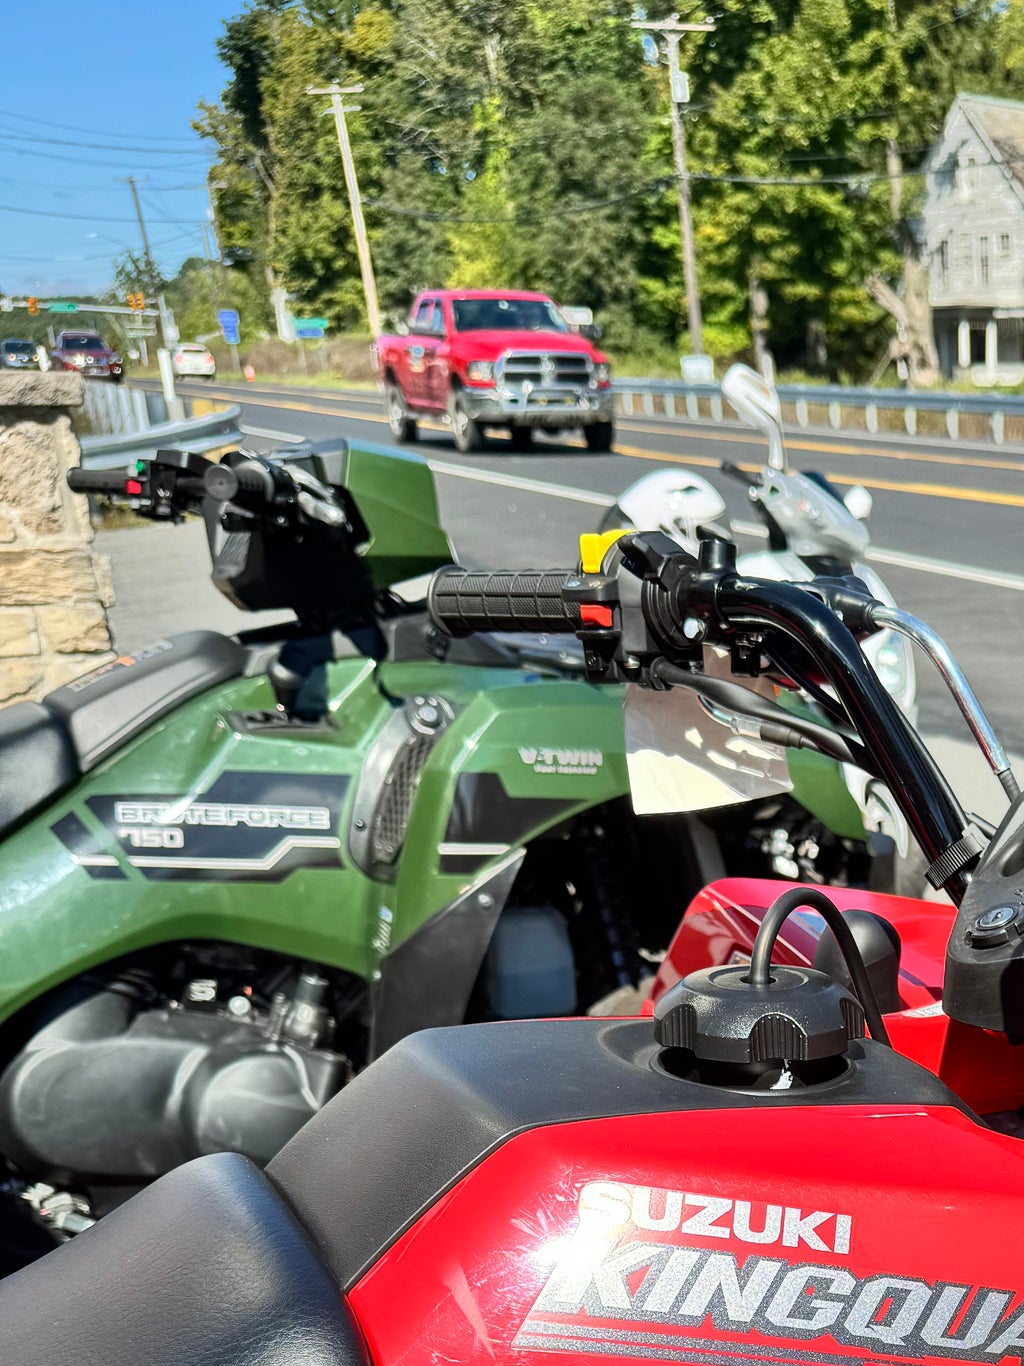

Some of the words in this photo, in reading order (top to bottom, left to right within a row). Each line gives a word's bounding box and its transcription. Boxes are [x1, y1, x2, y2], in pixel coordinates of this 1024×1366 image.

[519, 747, 603, 767] V-TWIN
[114, 801, 227, 825] BRTE
[118, 827, 184, 848] 750
[579, 1181, 852, 1254] SUZUKI
